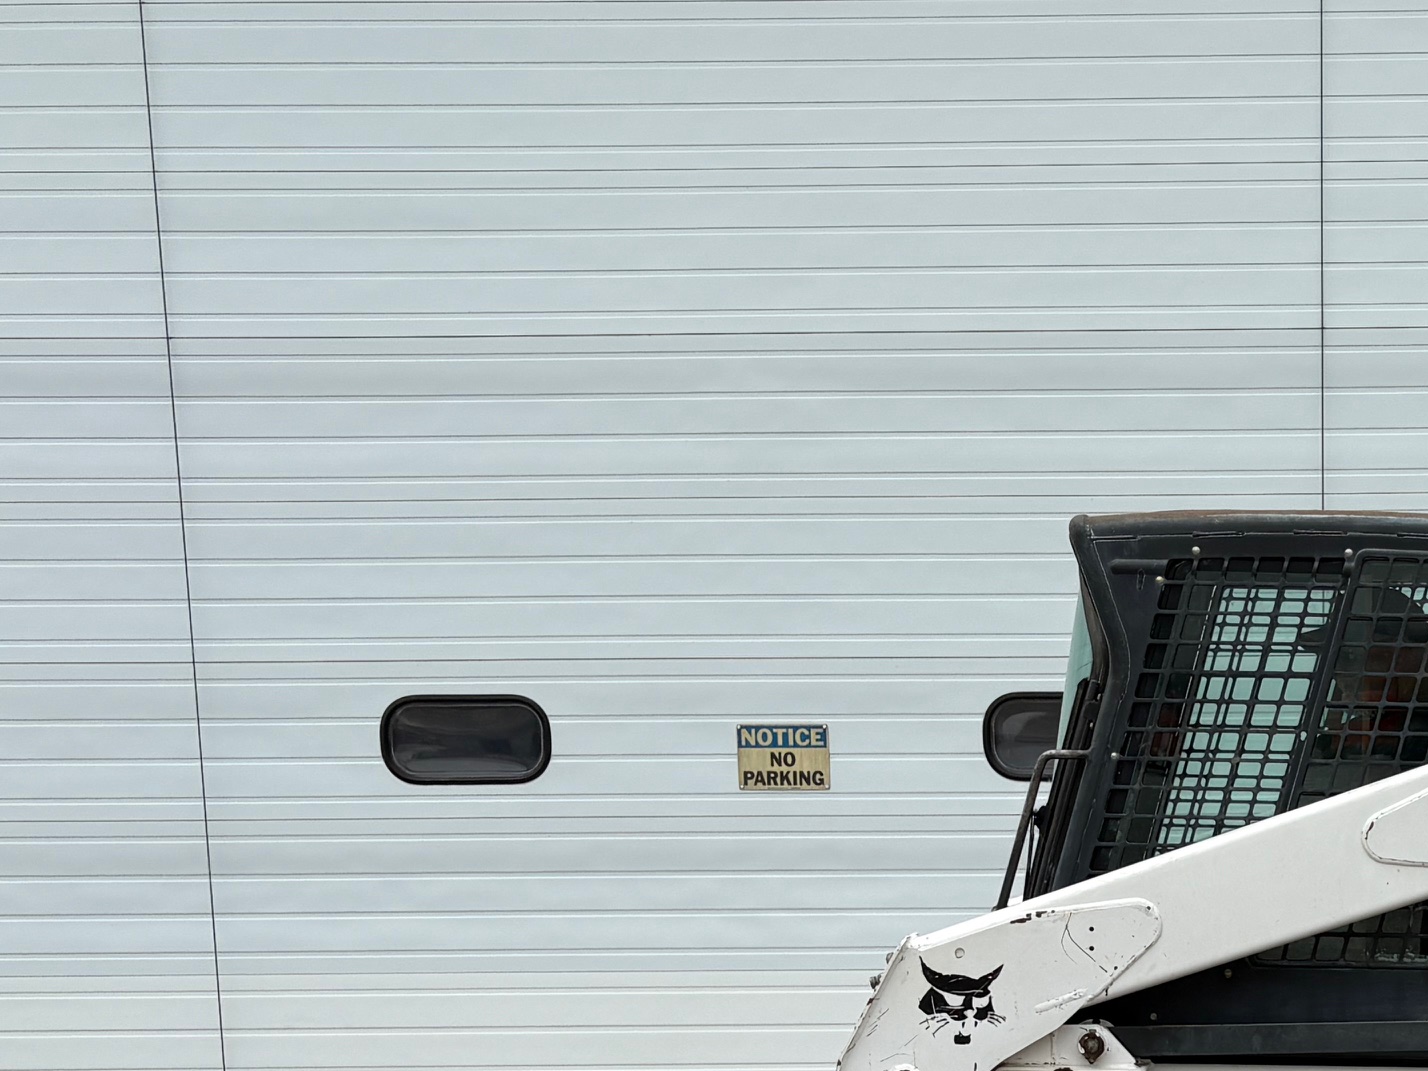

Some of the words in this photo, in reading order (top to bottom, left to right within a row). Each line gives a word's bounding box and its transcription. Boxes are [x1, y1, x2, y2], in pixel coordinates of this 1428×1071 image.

[741, 728, 824, 746] NOTICE
[770, 752, 796, 767] NO
[743, 771, 825, 786] PARKING
